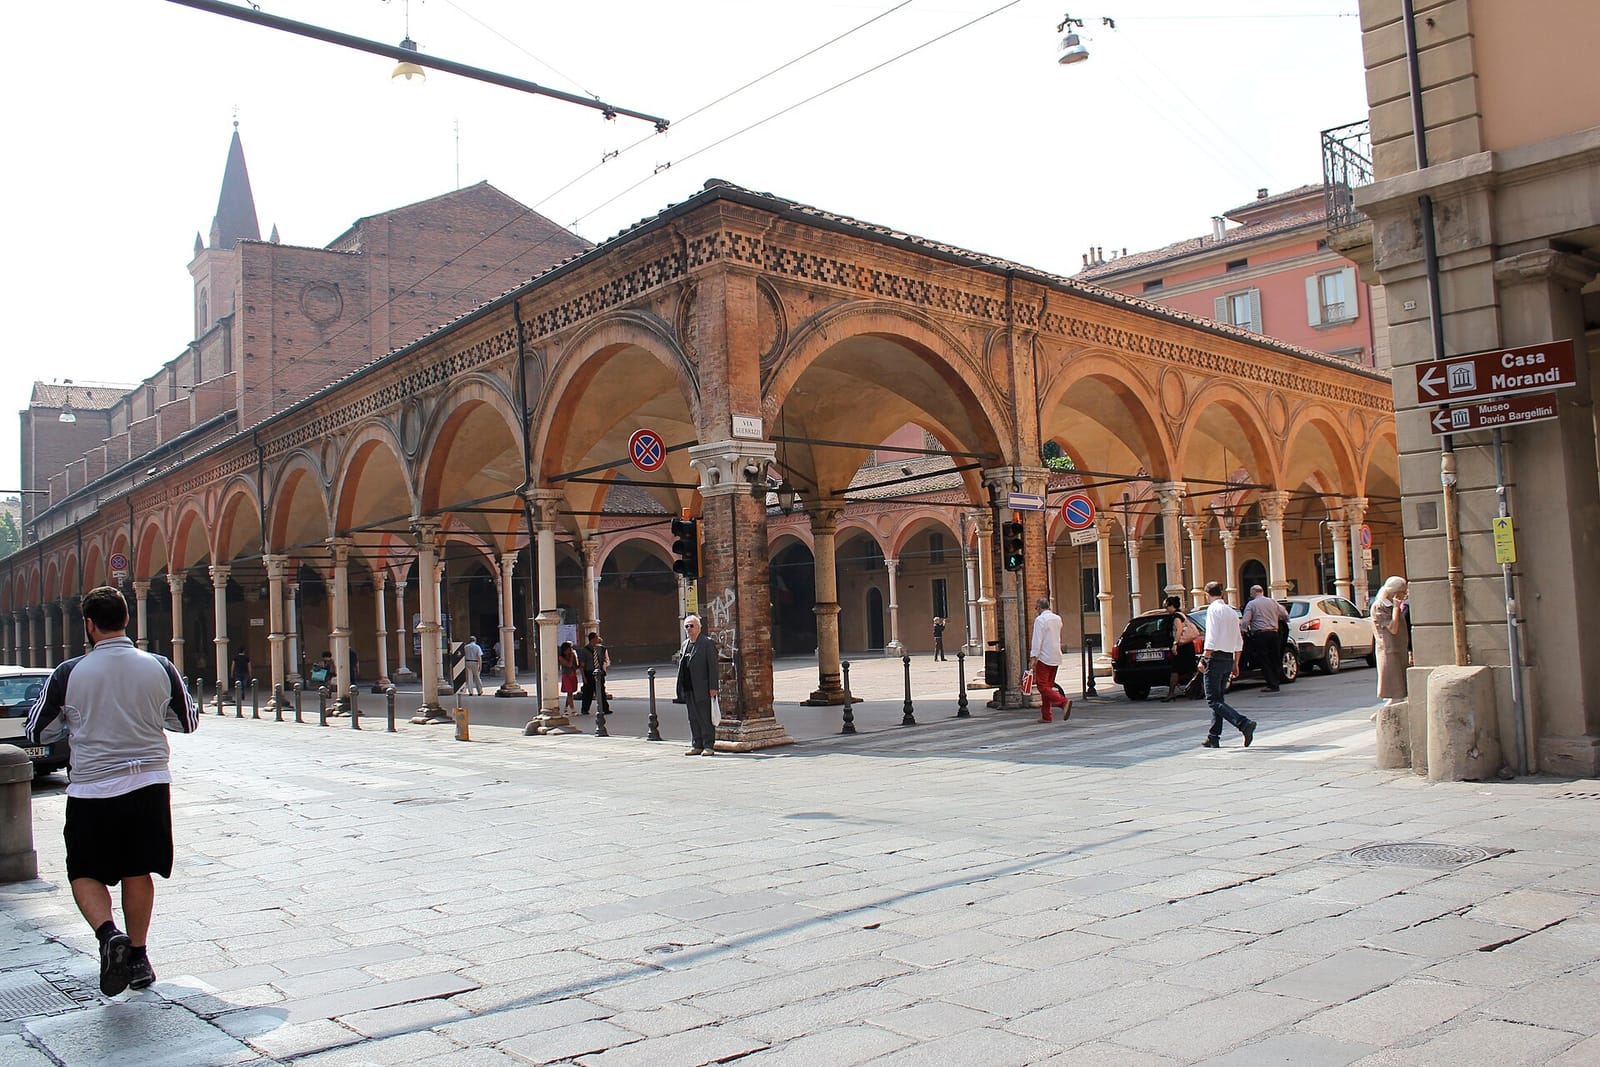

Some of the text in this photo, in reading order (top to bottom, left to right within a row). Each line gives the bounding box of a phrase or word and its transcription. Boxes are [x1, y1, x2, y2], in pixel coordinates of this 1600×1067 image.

[1501, 352, 1545, 369] Casa
[1491, 367, 1560, 390] Morandi
[1479, 403, 1510, 414] Museo
[1480, 406, 1553, 425] Davia Bargellini
